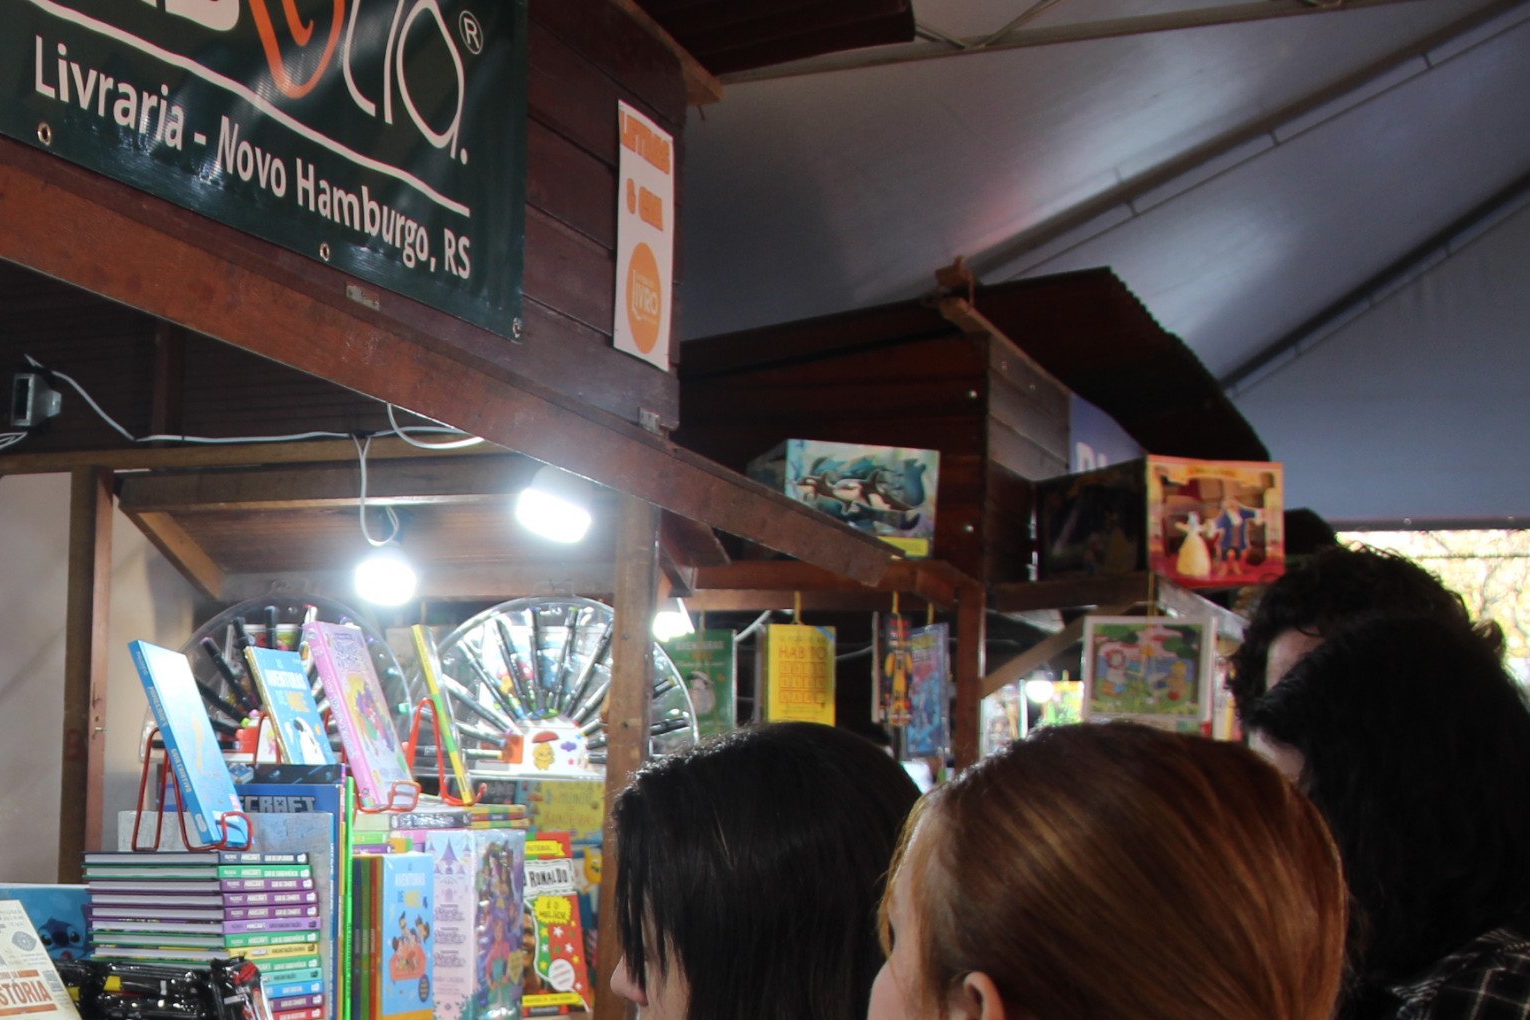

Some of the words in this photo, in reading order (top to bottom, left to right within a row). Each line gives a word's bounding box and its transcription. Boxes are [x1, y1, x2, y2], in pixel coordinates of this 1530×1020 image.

[35, 34, 185, 151] Livraria
[217, 115, 285, 198] Novo
[296, 157, 436, 272] Hamburgo,
[443, 226, 470, 280] RS
